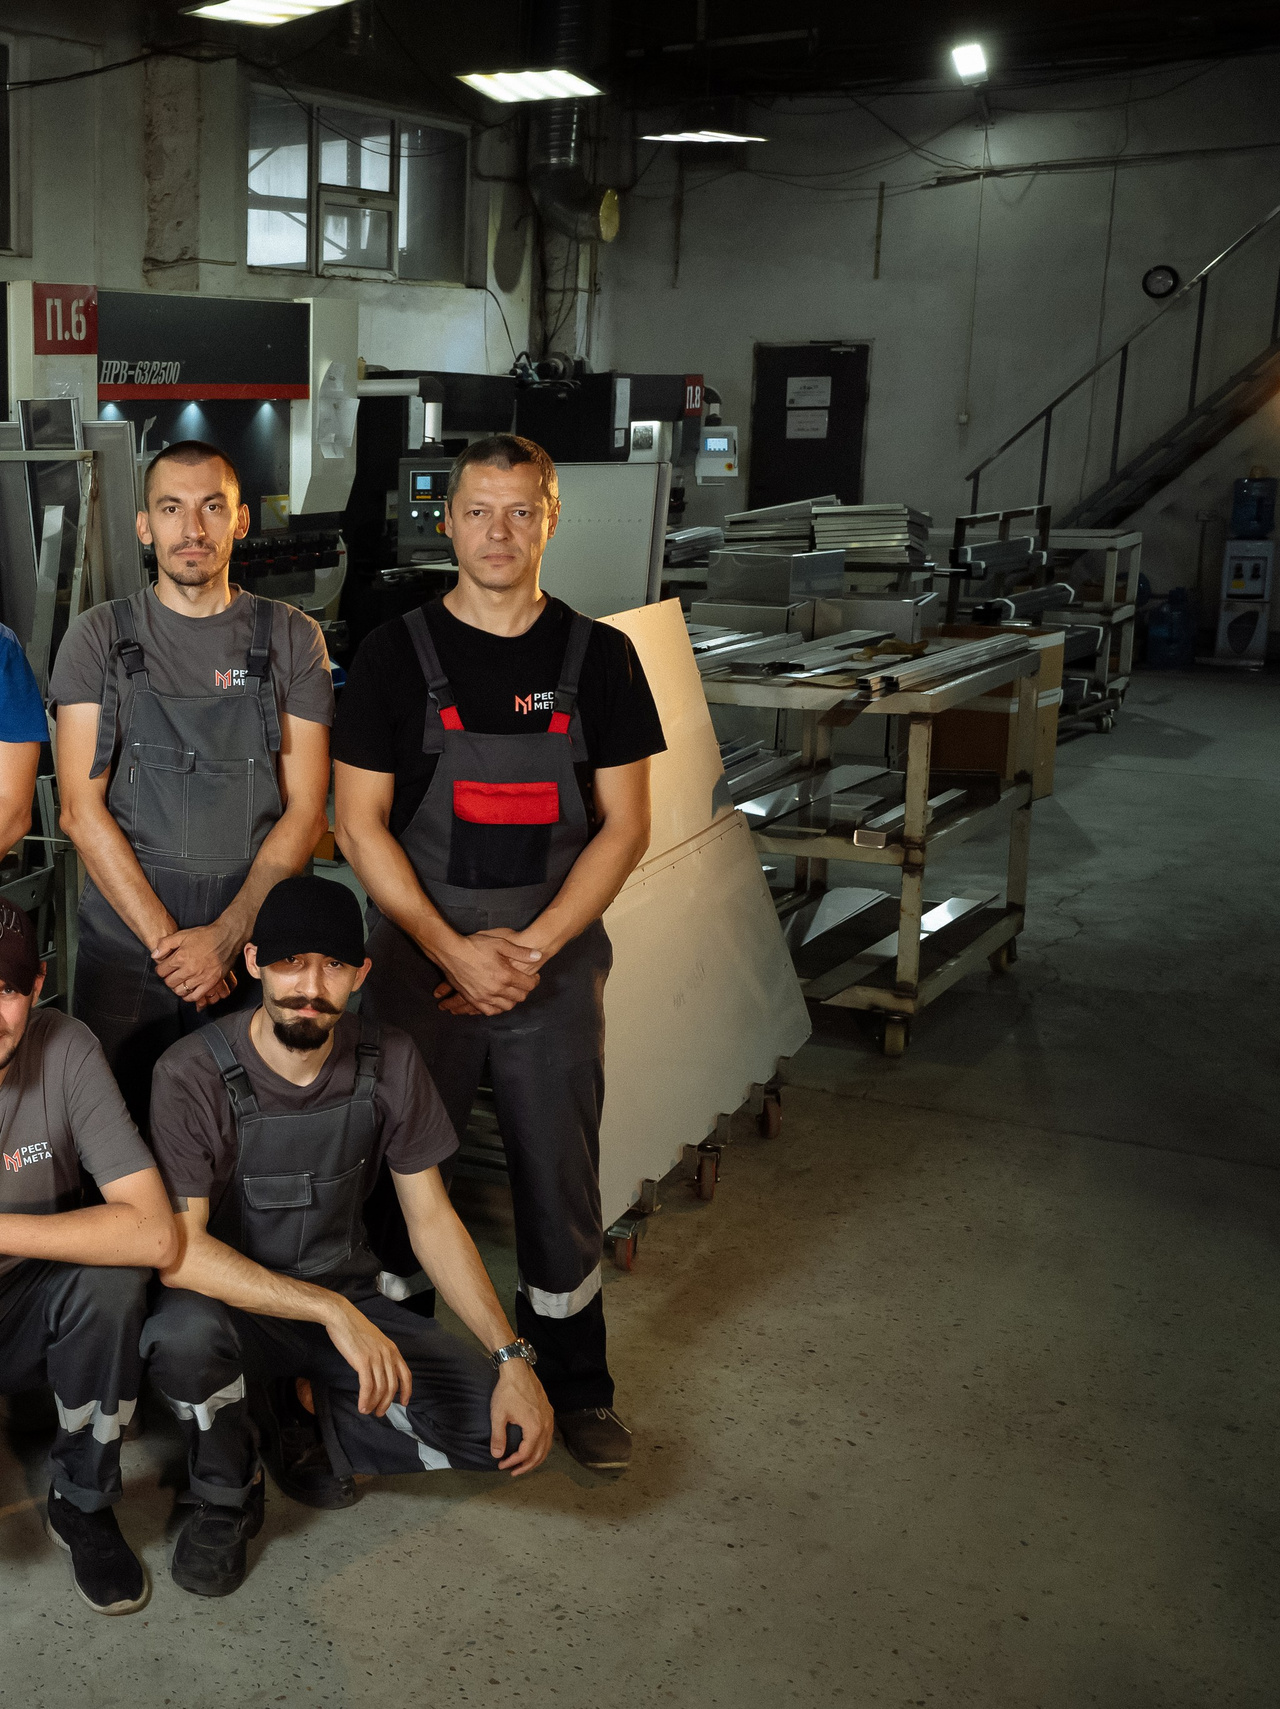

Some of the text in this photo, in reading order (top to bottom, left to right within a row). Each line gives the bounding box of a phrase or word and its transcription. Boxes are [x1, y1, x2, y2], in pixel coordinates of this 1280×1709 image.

[45, 298, 86, 341] П.6
[99, 360, 181, 385] HPB-63/2500
[533, 691, 554, 702] РЕС
[533, 701, 554, 711] МЕТ
[21, 1141, 48, 1156] РЕСТ
[22, 1151, 53, 1166] МЕТА
